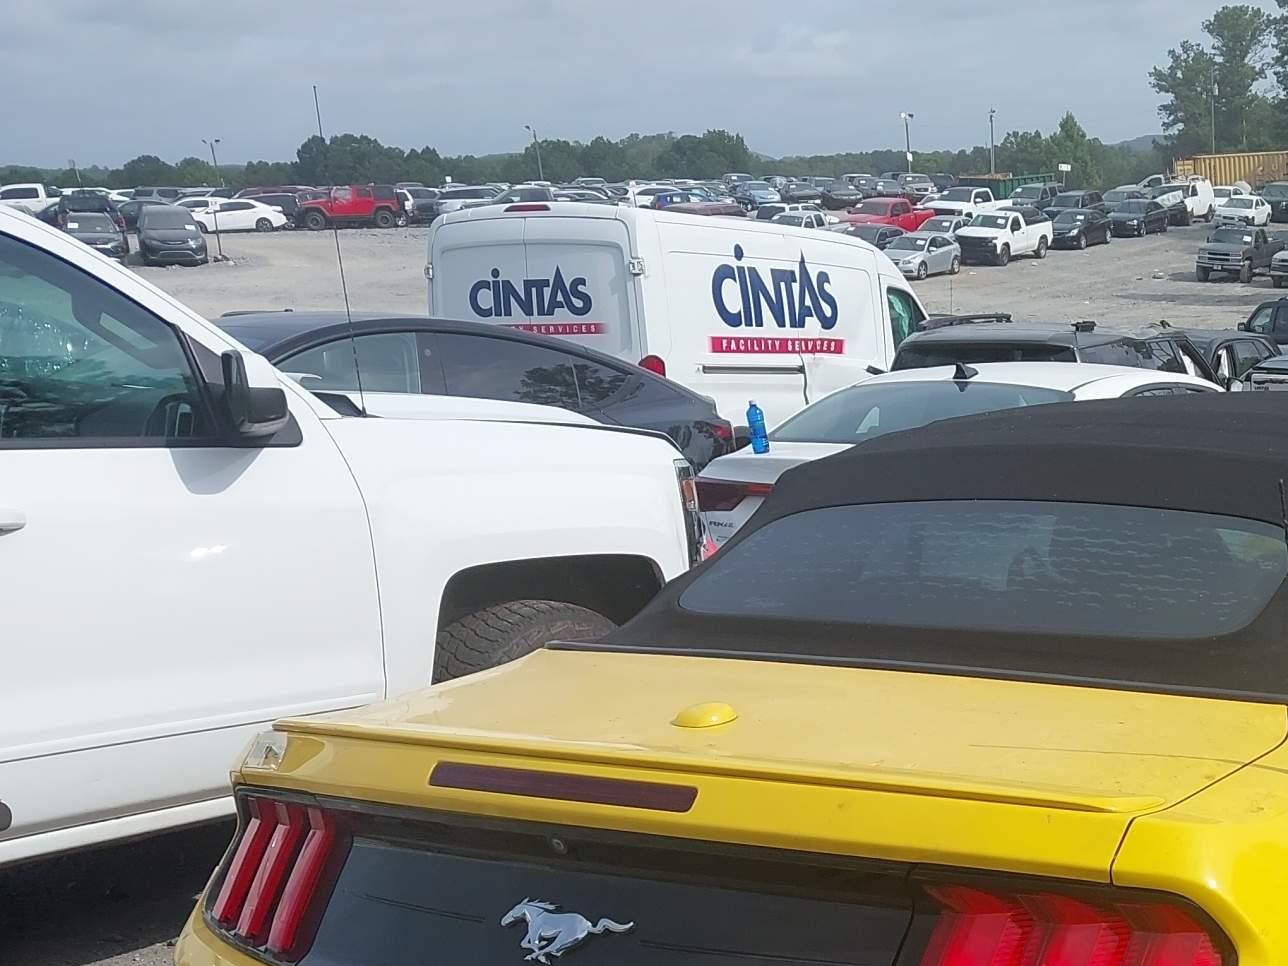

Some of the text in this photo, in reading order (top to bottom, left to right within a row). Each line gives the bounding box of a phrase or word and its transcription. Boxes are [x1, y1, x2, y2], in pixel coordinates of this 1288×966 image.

[469, 264, 593, 318] CINTAS
[711, 243, 839, 331] CINTAS
[533, 324, 596, 334] SERVICES
[722, 339, 836, 352] FACILITY SEVCES
